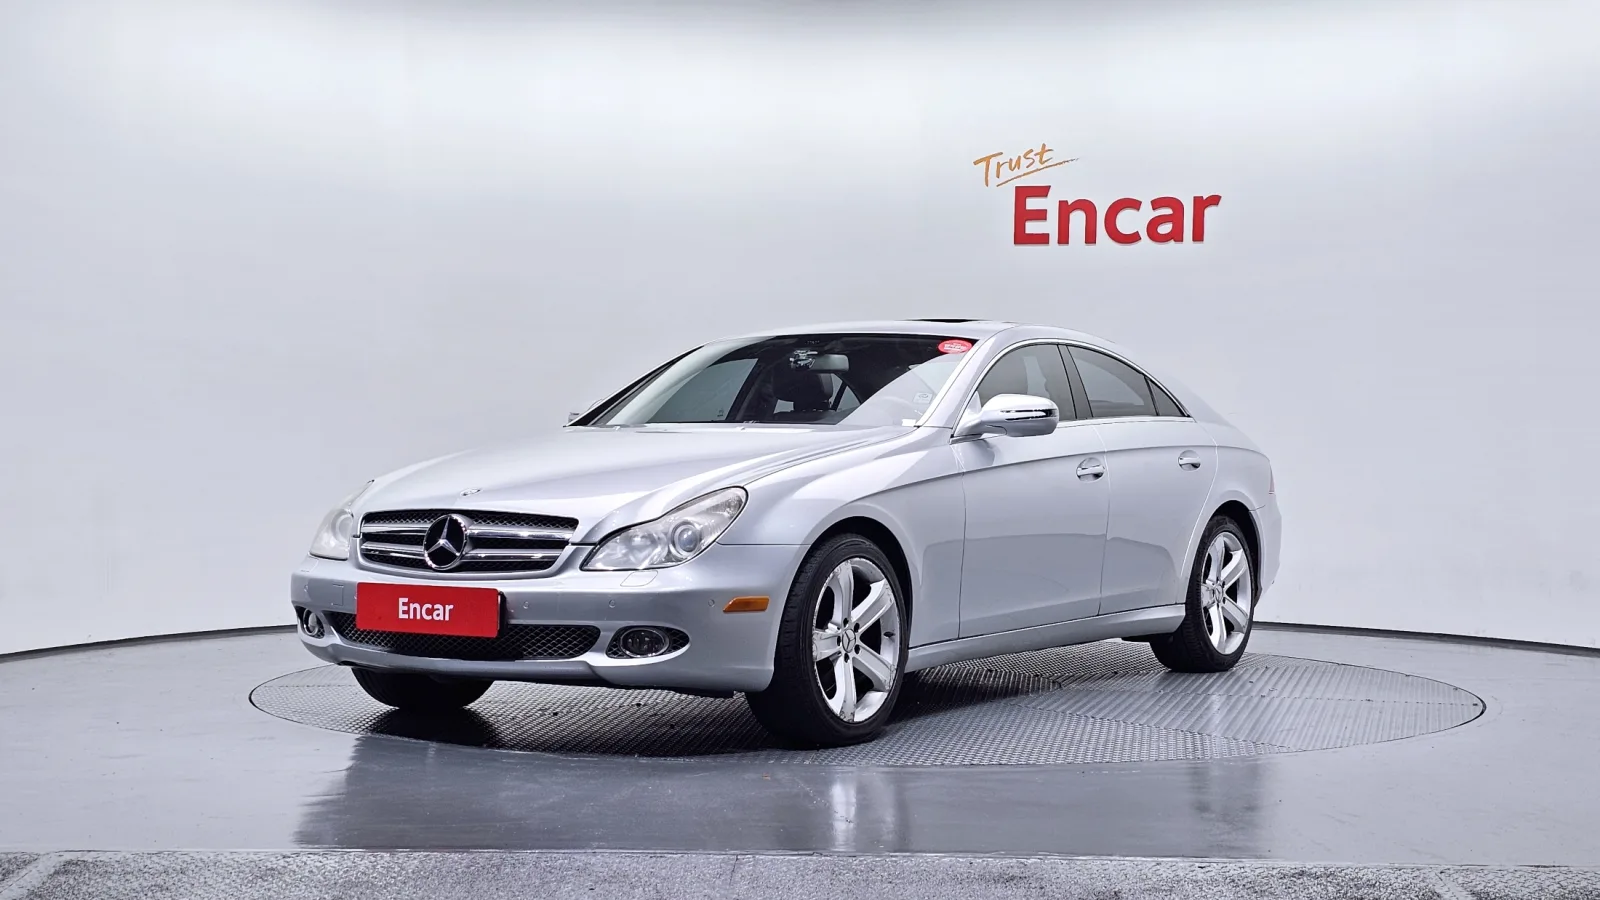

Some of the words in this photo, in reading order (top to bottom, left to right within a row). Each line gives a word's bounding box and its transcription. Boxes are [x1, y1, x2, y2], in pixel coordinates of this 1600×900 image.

[973, 143, 1054, 187] Trust
[1013, 185, 1222, 245] Encar
[398, 597, 454, 621] Encar
